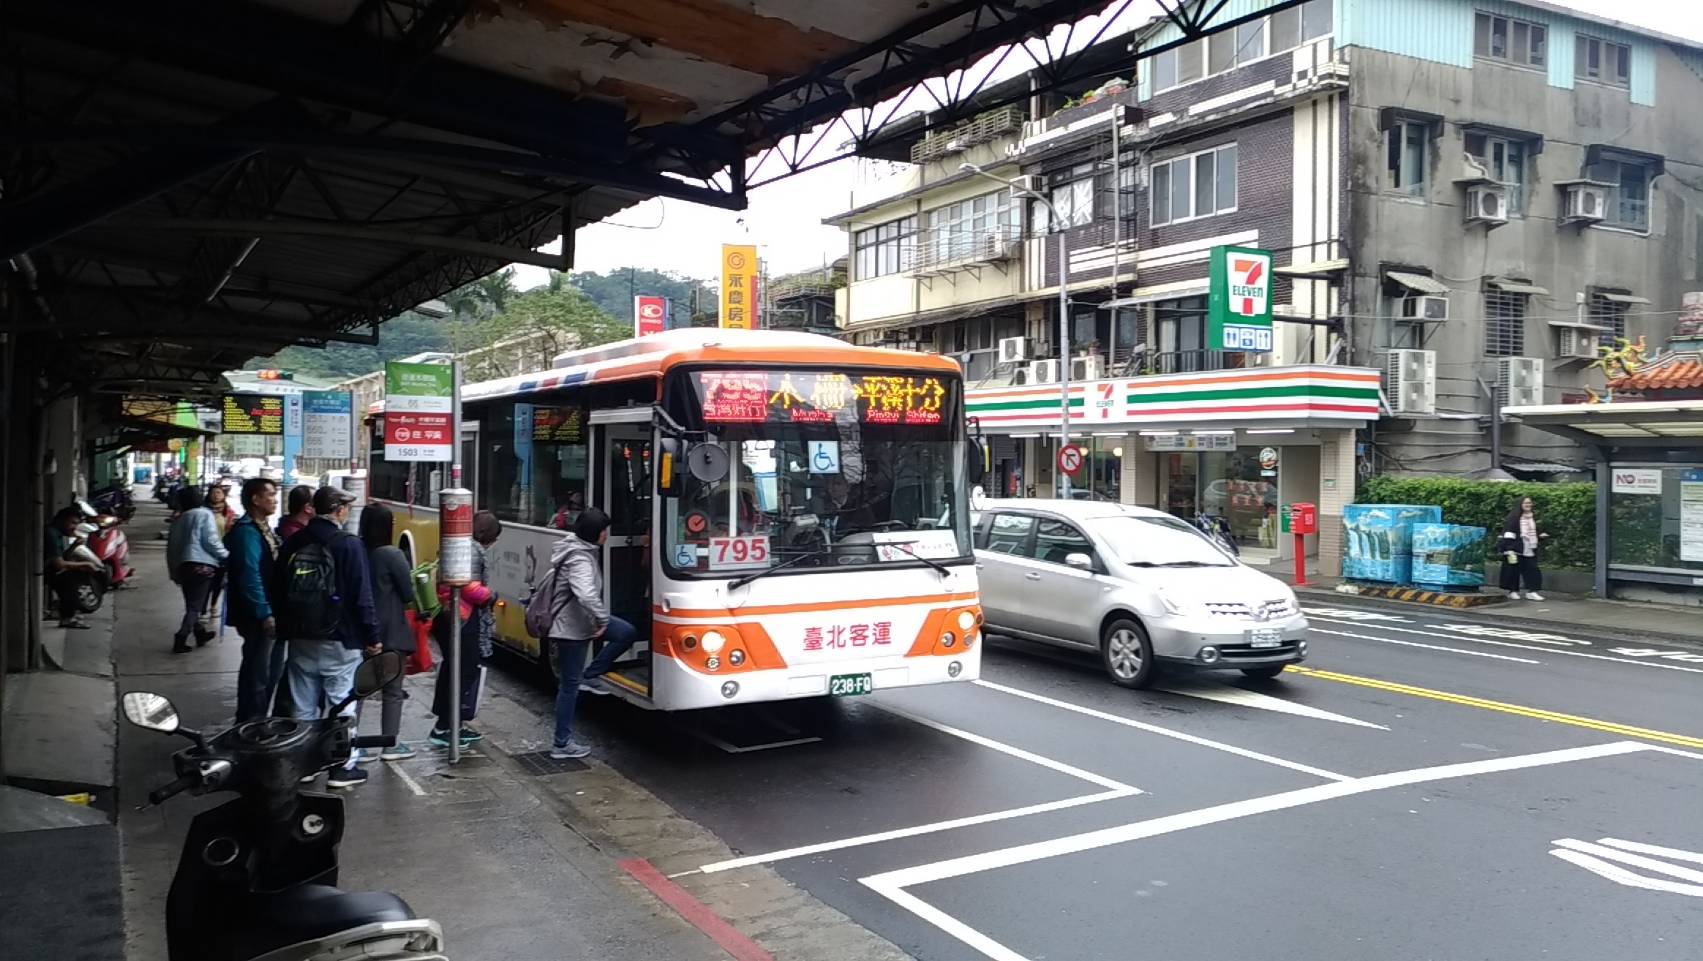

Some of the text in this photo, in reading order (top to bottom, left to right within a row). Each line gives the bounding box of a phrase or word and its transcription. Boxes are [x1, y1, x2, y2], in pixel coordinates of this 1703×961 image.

[1234, 259, 1262, 315] 7
[714, 538, 766, 562] 795
[803, 621, 892, 651] 臺北客運
